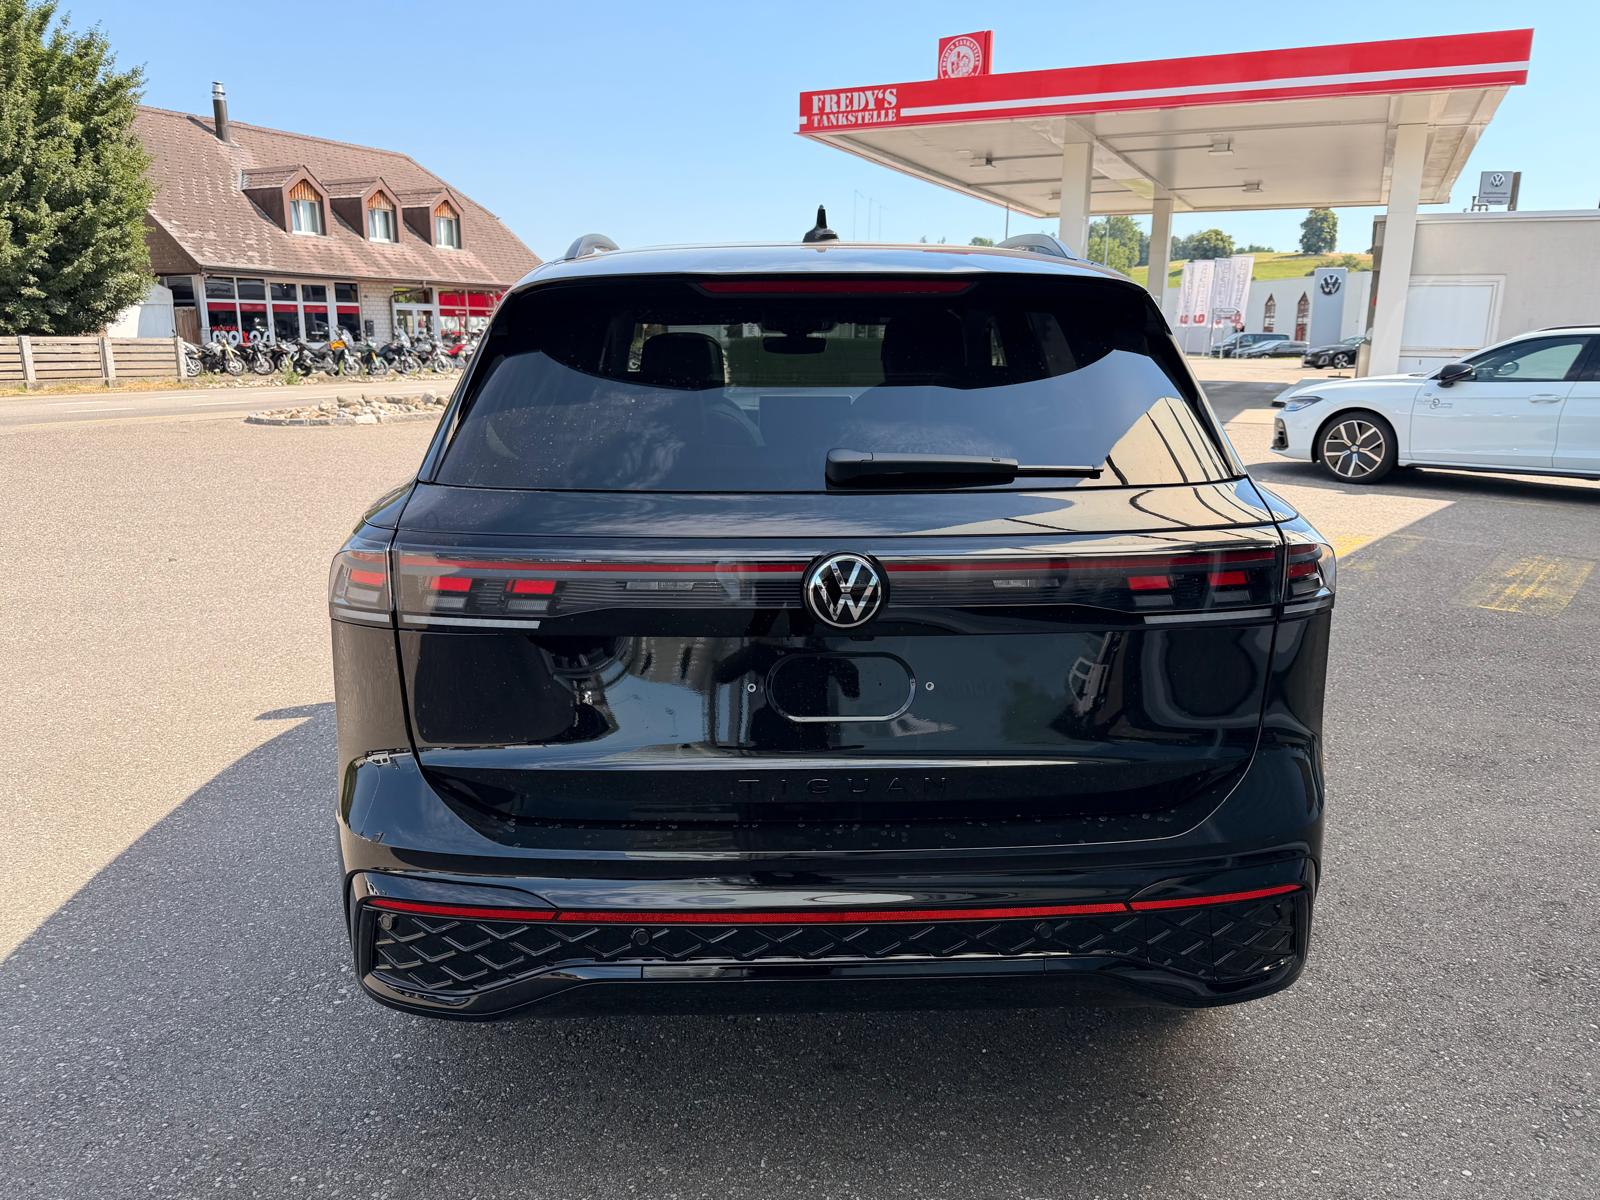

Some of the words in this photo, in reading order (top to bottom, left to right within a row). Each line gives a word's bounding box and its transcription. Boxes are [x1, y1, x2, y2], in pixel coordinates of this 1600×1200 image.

[812, 109, 897, 128] TANKSTELLE
[1490, 173, 1505, 188] VW
[1320, 274, 1341, 296] VW
[810, 555, 882, 628] VW
[738, 777, 947, 795] TIGUAN
